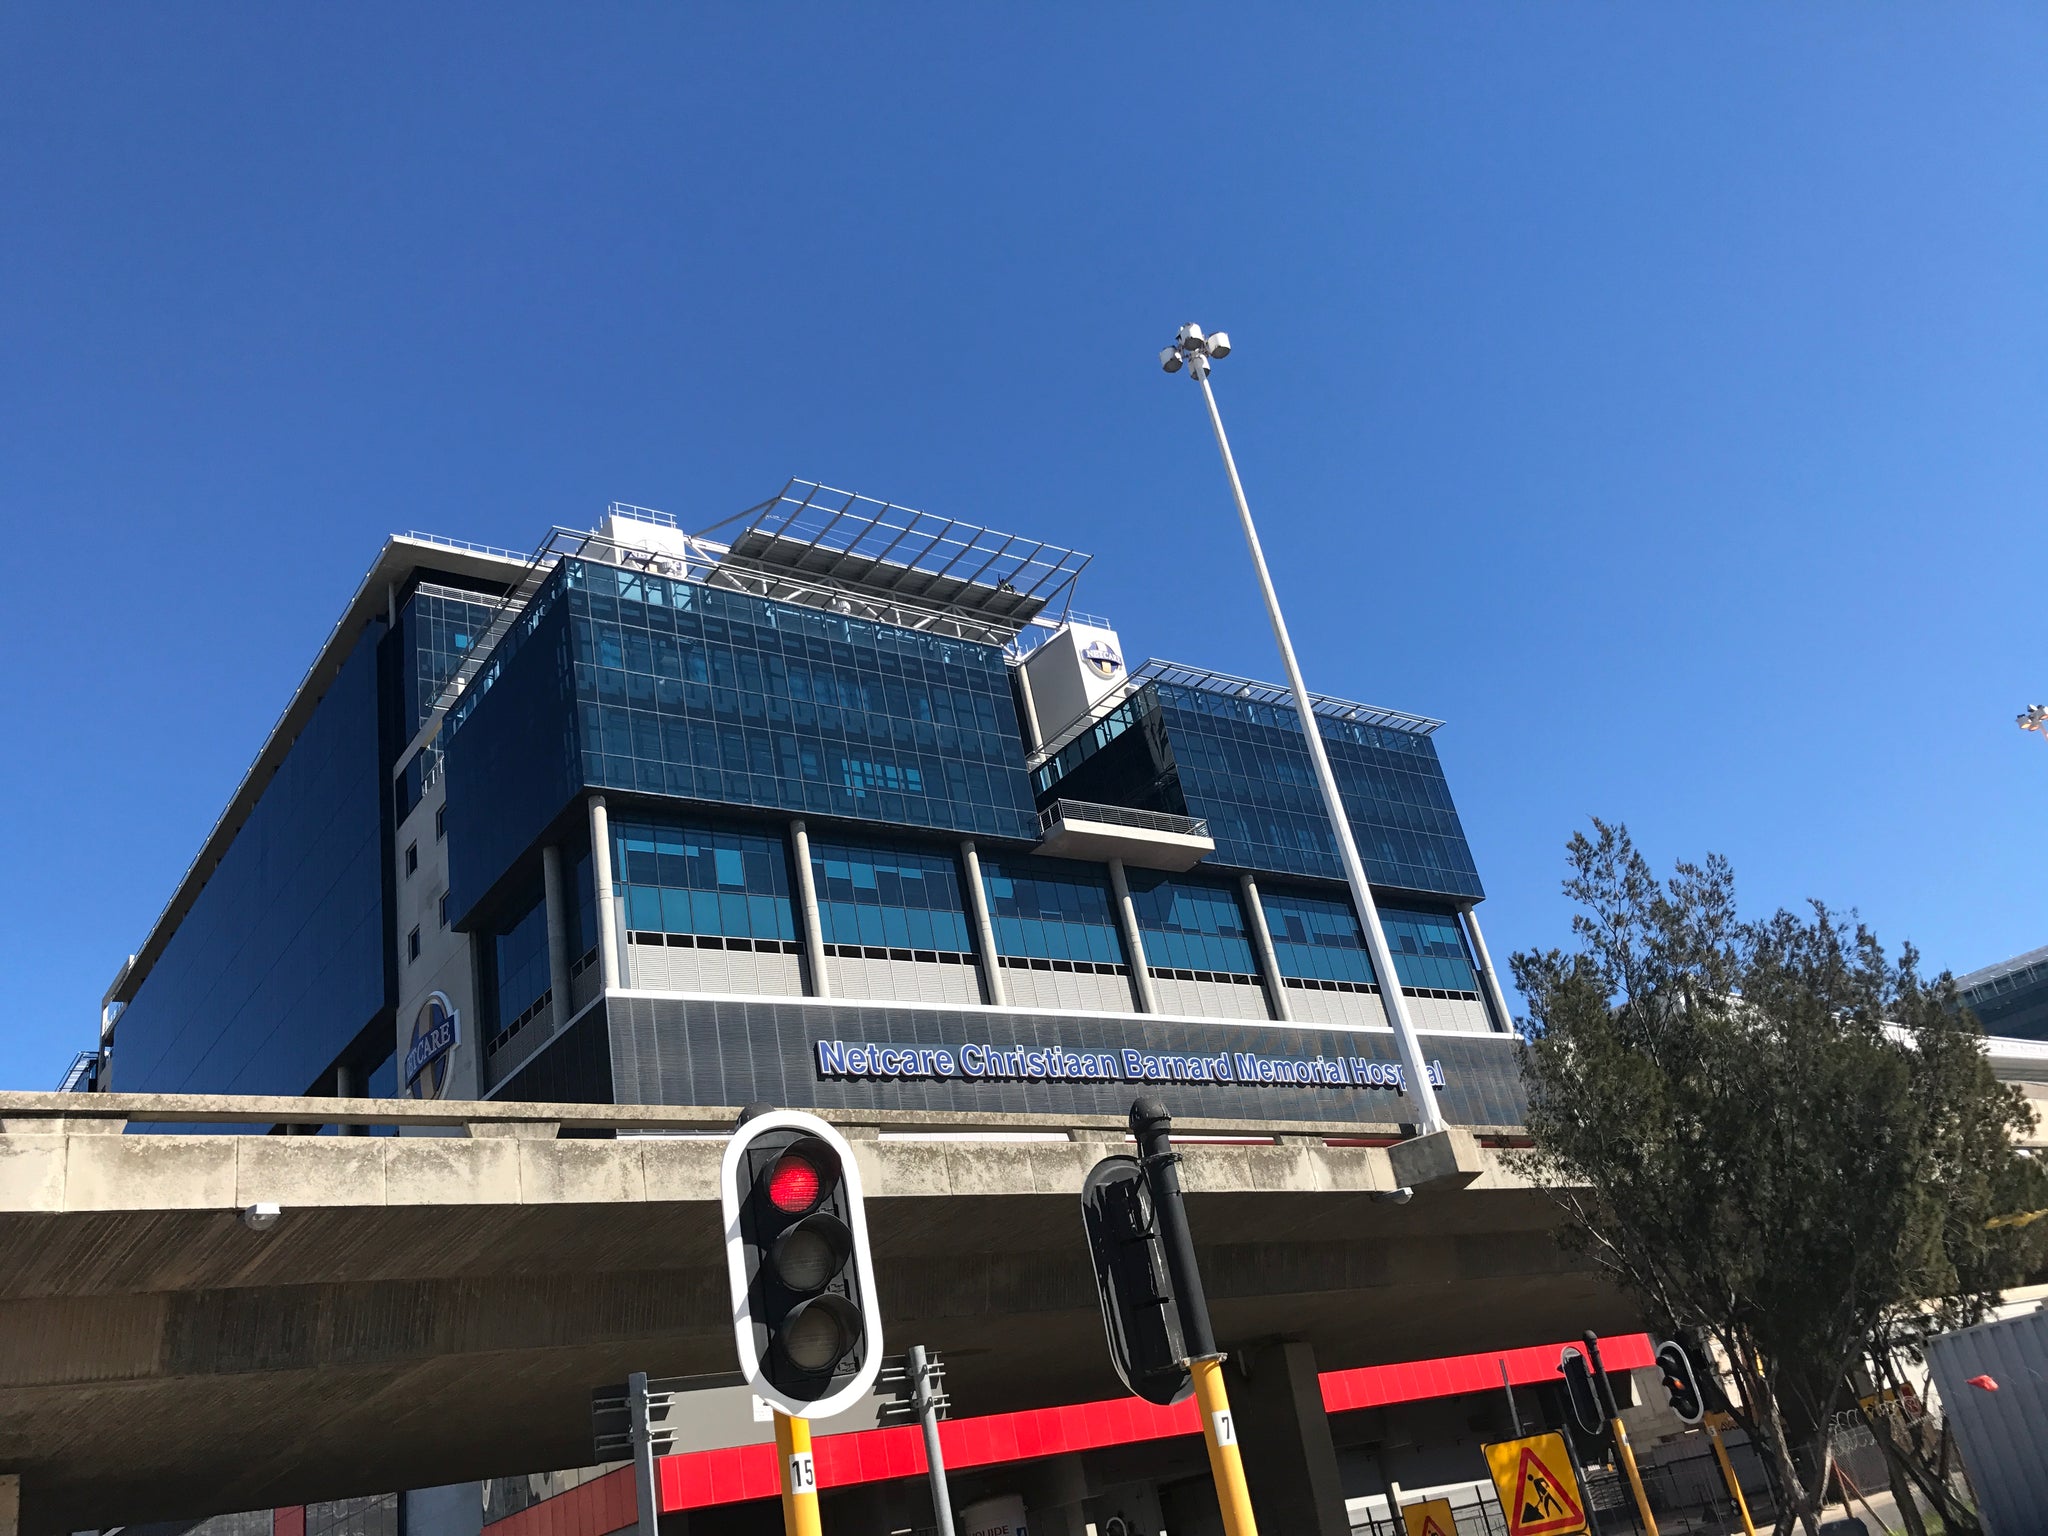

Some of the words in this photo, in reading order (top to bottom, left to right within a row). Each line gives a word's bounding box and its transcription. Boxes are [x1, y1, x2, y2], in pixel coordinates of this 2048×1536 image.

[817, 1040, 954, 1076] Netcare
[960, 1043, 1119, 1078] Christiaan
[1122, 1048, 1233, 1081] Barnard
[1234, 1053, 1350, 1085] Memorial
[1349, 1057, 1446, 1092] Hospal
[1221, 1416, 1230, 1440] 7
[792, 1459, 814, 1487] 15
